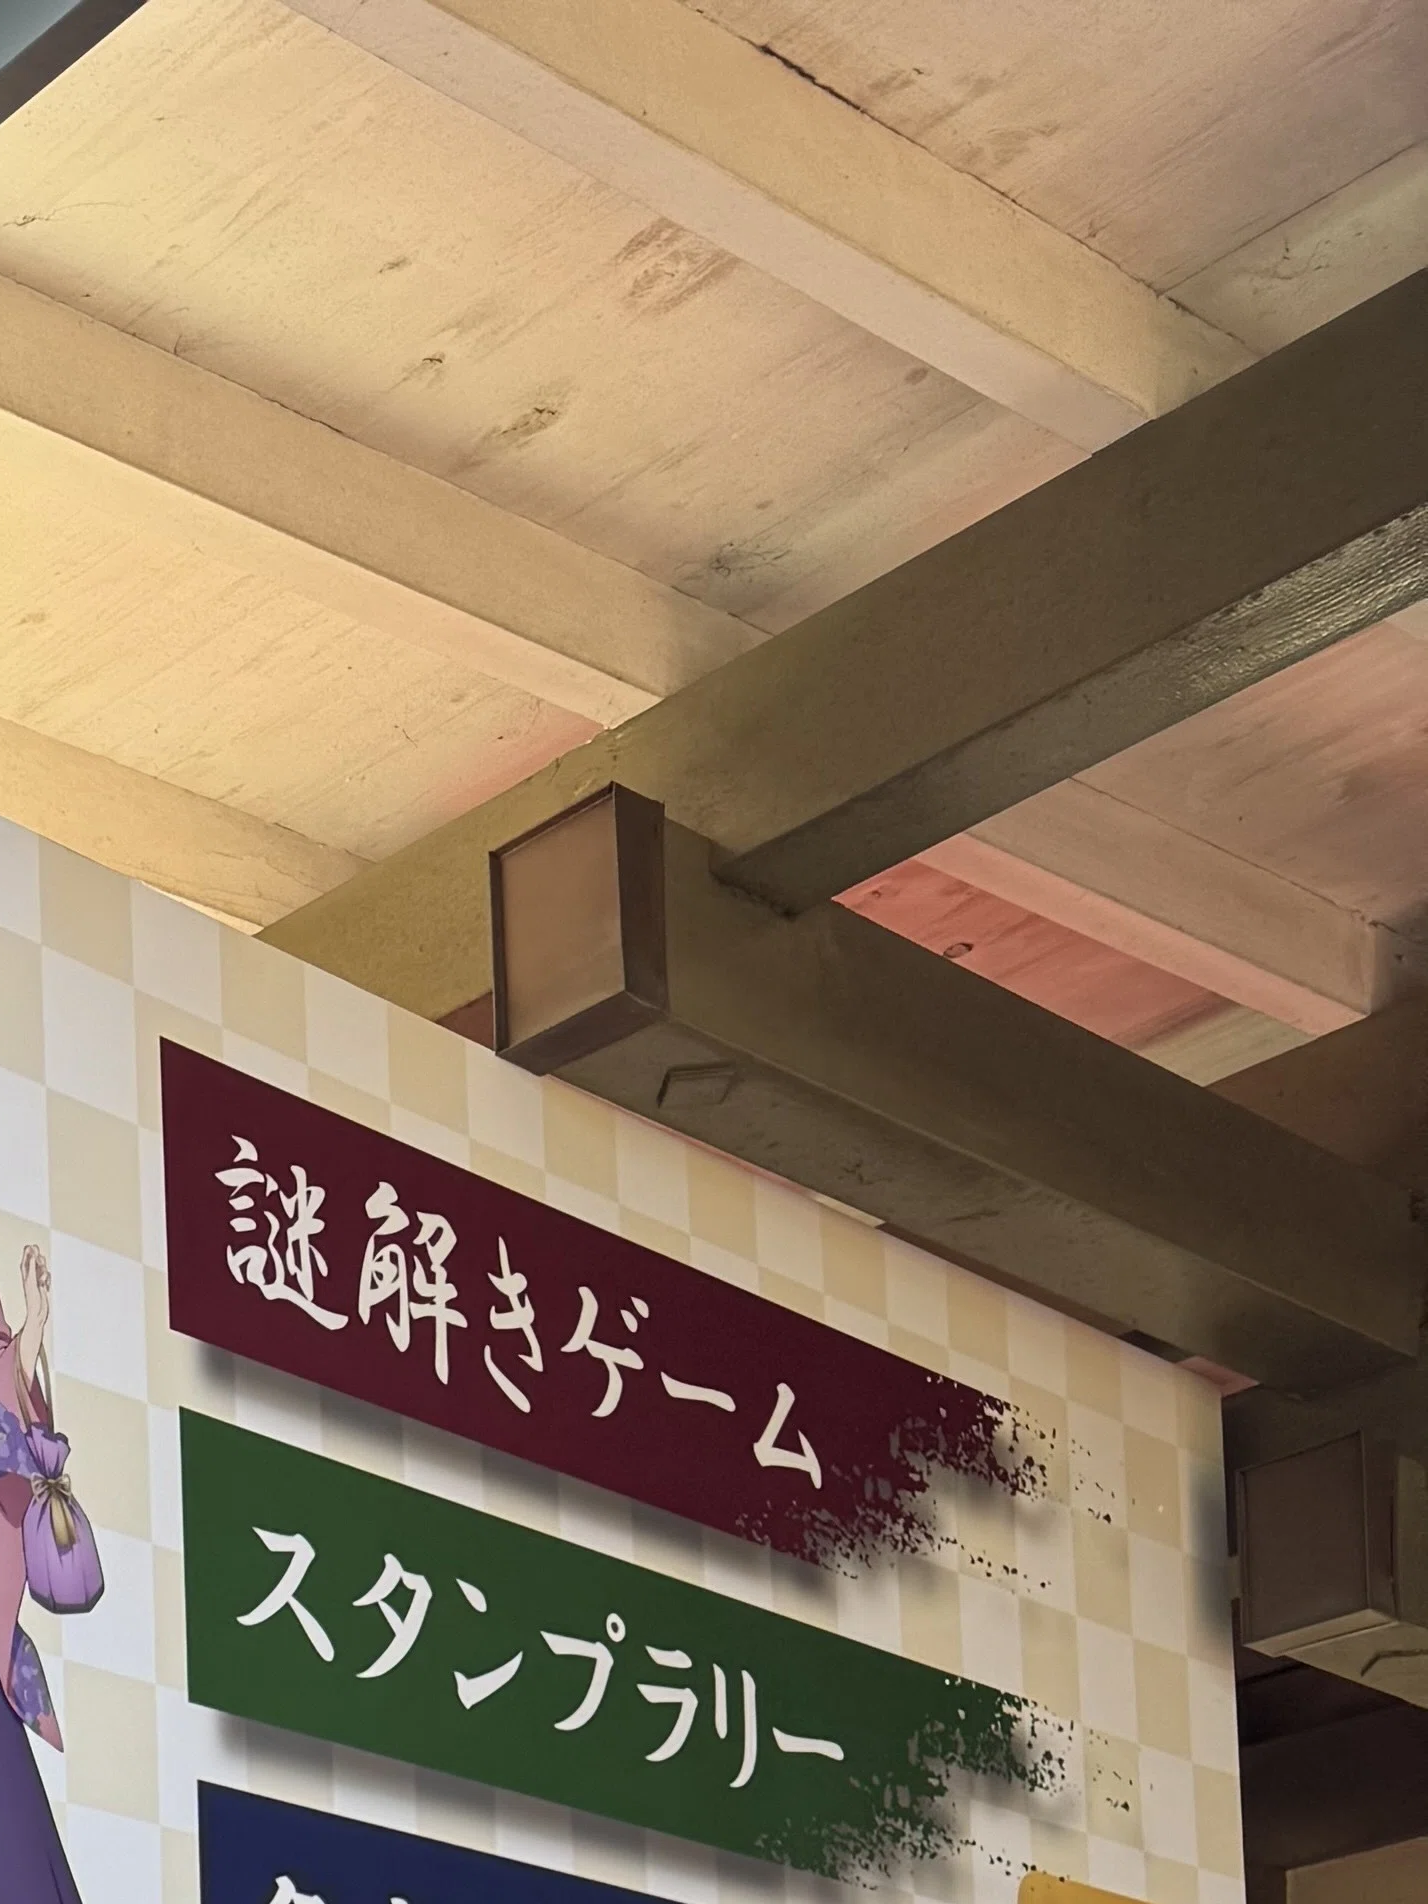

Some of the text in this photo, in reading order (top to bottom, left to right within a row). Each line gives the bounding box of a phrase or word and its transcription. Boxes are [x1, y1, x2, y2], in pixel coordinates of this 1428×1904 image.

[214, 1136, 823, 1489] 謎解きゲーム
[237, 1526, 845, 1788] スタンプラリー
